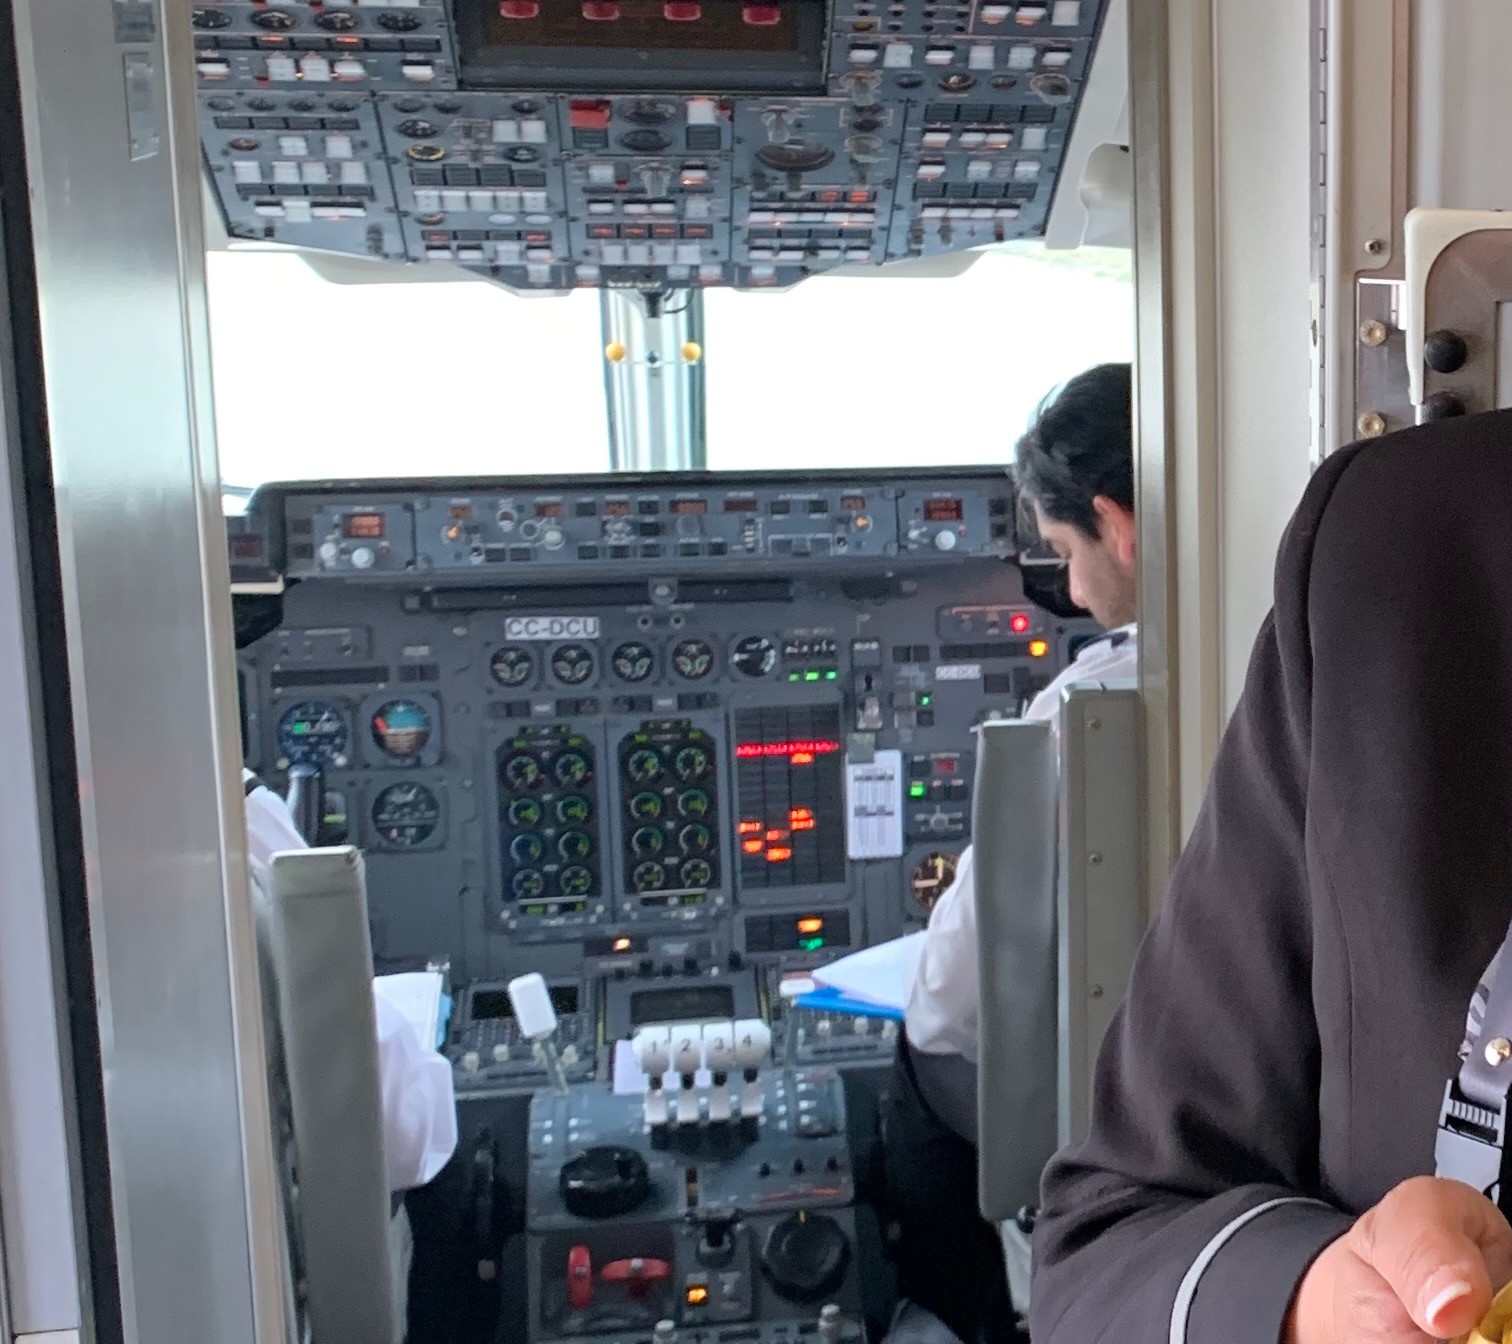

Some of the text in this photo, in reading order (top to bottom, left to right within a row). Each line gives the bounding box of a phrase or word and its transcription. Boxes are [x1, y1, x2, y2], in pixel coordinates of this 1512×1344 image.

[681, 1038, 691, 1052] 2
[716, 1036, 724, 1049] 3
[742, 1032, 752, 1046] 4
